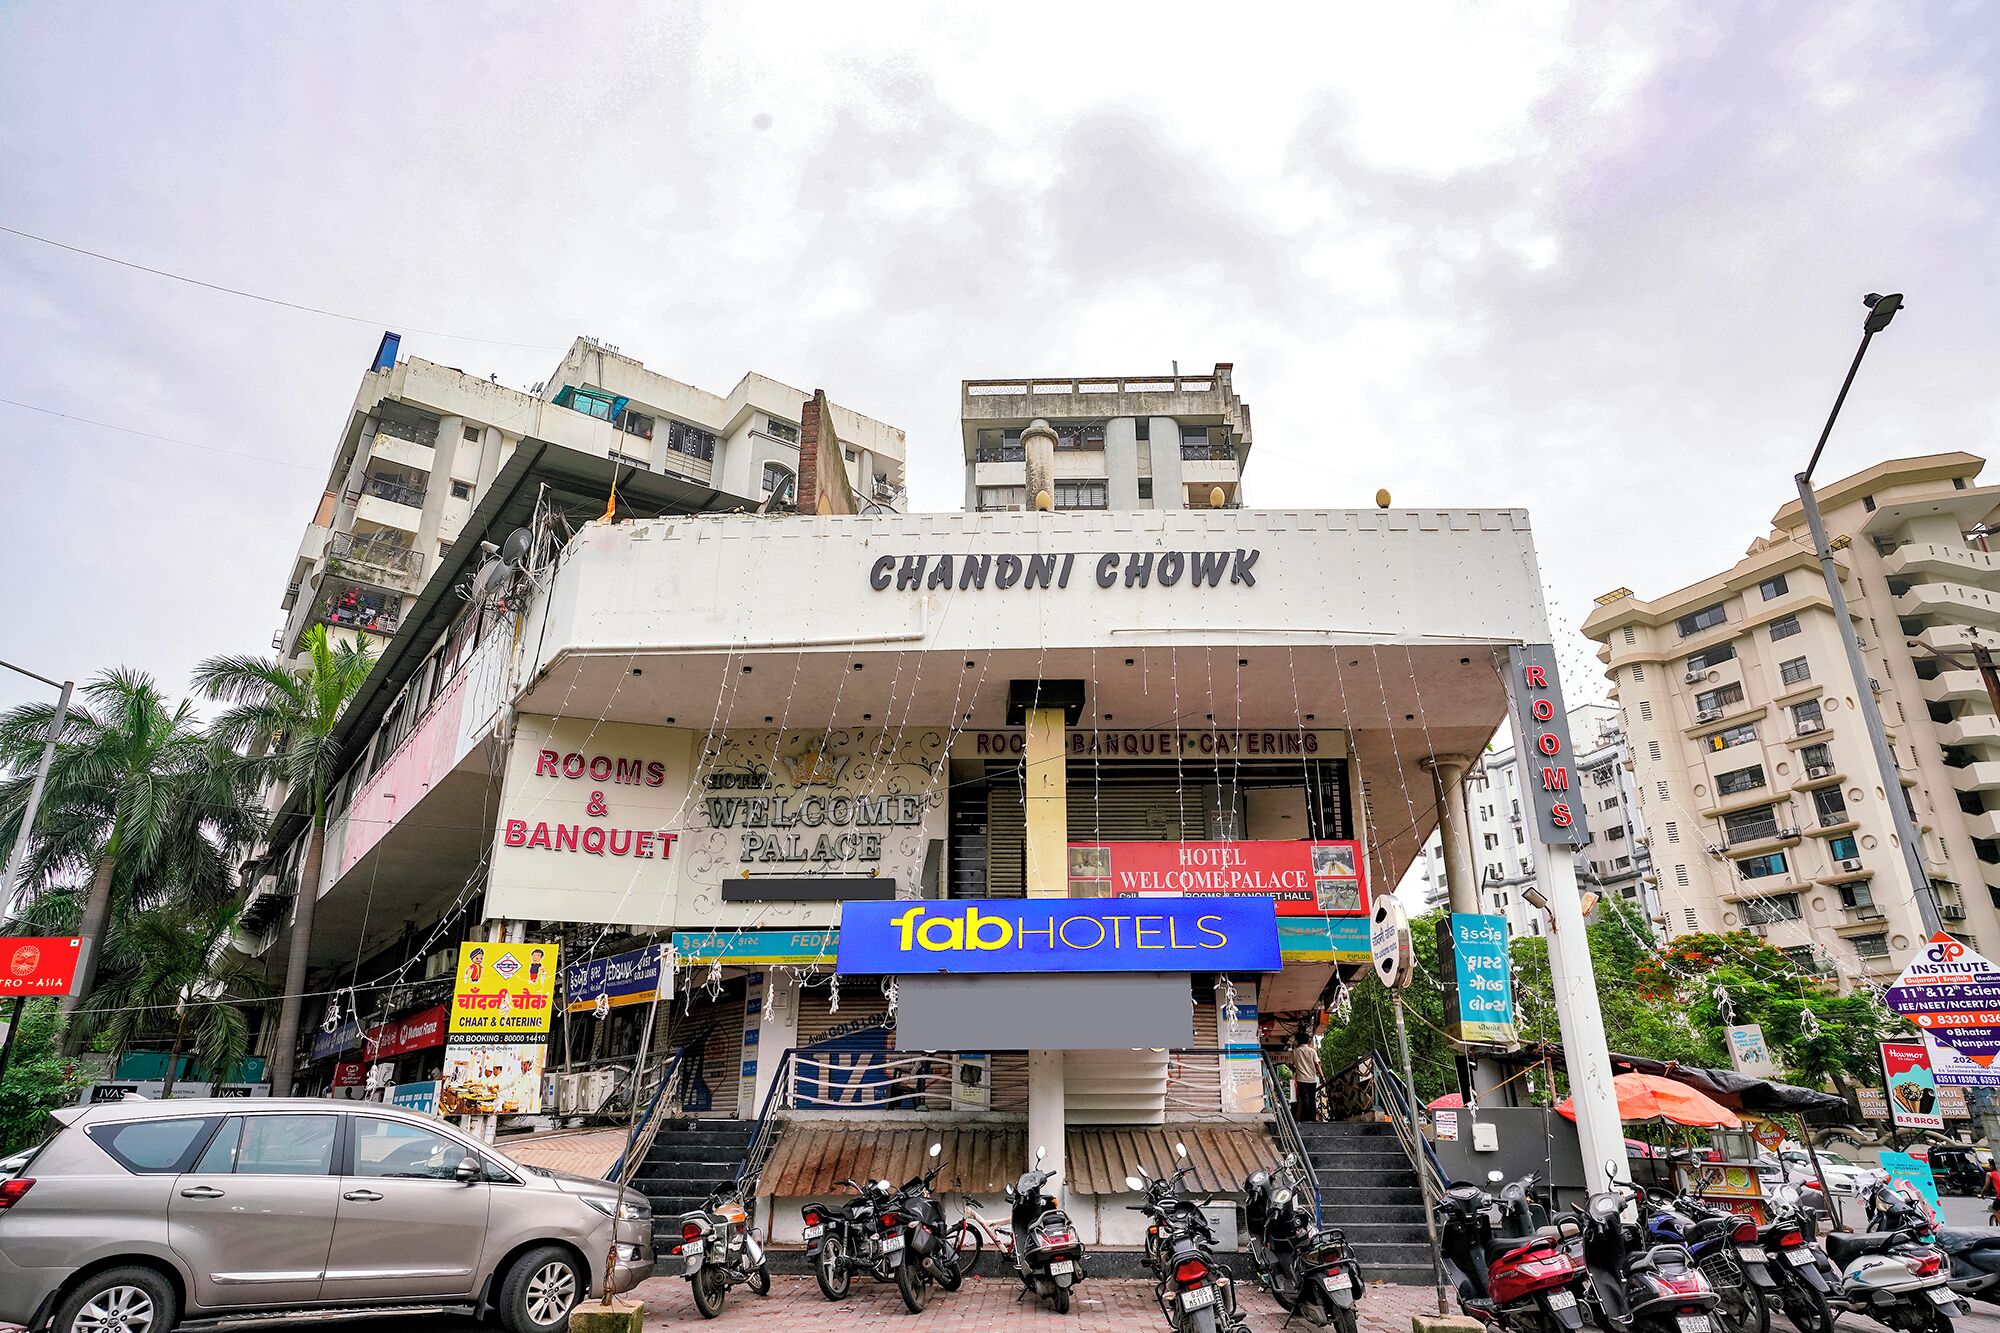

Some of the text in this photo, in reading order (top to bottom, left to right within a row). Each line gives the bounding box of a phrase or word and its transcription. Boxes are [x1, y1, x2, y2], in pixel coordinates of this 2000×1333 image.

[869, 548, 1261, 591] CHANDNI CHOWK
[1072, 733, 1189, 756] BANQUET
[1200, 732, 1319, 755] CATERING
[1525, 665, 1574, 828] ROOMS
[535, 750, 666, 787] ROOMS
[707, 773, 772, 789] HOTEL
[585, 790, 609, 816] &
[705, 795, 923, 829] WELCOME
[504, 819, 678, 860] BANQUET
[739, 833, 882, 863] PALACE
[1179, 848, 1247, 866] HOTEL
[1120, 870, 1308, 889] WELCOME PALACE
[1284, 892, 1310, 900] HALL
[1911, 962, 1990, 974] INSTITUTE
[36, 978, 63, 987] ASIA
[459, 1016, 542, 1027] CHAAT & CATERING
[1937, 1014, 1975, 1024] 83201
[828, 1020, 860, 1038] GOLD
[1954, 1028, 1992, 1036] Bhatar
[449, 1034, 464, 1043] FOR
[465, 1034, 500, 1043] BOOKING
[504, 1034, 525, 1043] 80000
[525, 1034, 546, 1043] 14410
[1952, 1039, 2000, 1049] Nanpura
[1888, 1049, 1924, 1059] Havmor
[1936, 1075, 1957, 1084] 63518
[100, 1089, 129, 1098] IVAS
[1897, 1115, 1940, 1125] B.R BROS
